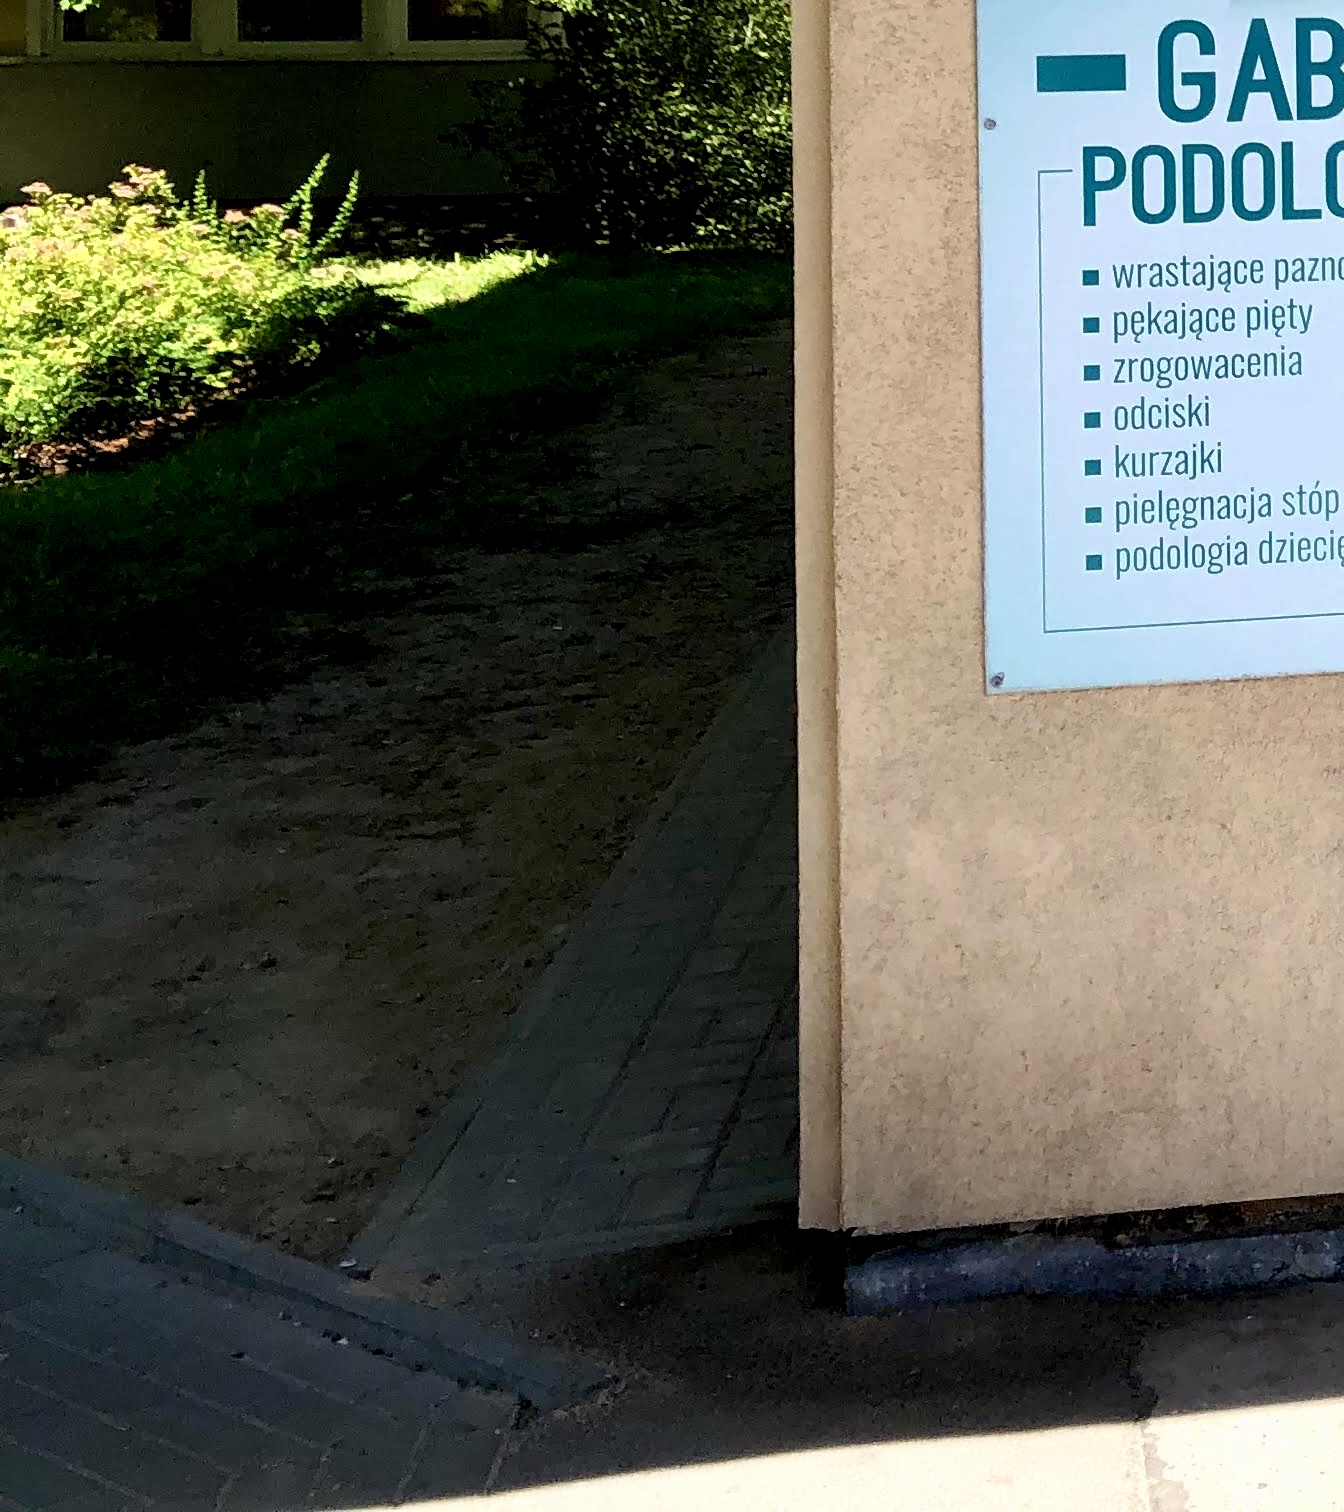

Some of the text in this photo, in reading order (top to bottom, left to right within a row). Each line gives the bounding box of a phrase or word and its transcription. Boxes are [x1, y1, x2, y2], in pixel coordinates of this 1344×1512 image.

[1113, 255, 1263, 293] wrastające
[1114, 299, 1312, 343] pękające pięty
[1114, 345, 1302, 388] zrogowacenia
[1115, 394, 1209, 430] odciski
[1115, 441, 1221, 480] kurzajki
[1116, 481, 1339, 532] pielęgnacja stóp
[1117, 535, 1247, 580] podologia
